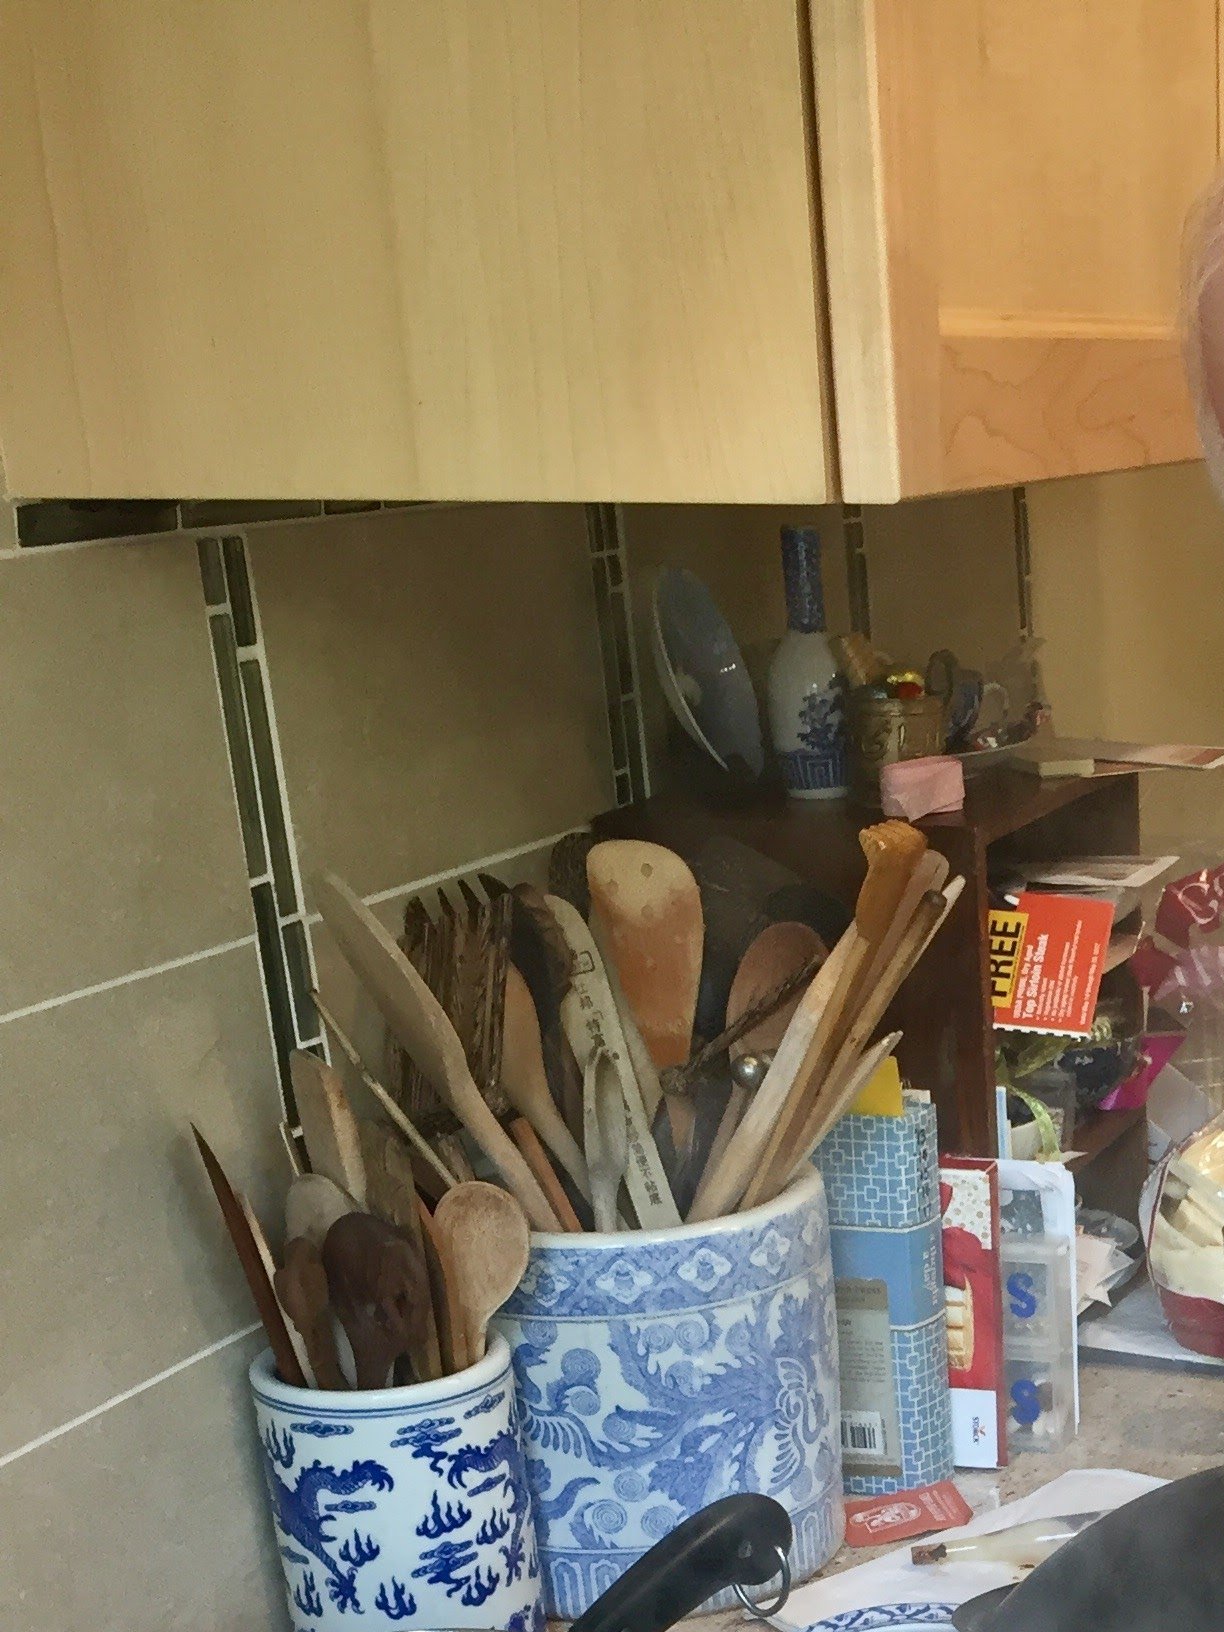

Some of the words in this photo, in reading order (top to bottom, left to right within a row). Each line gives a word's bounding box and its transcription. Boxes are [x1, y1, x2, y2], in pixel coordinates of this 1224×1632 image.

[990, 920, 1021, 998] FREE
[1033, 933, 1049, 962] Steak
[1026, 964, 1042, 998] Sirloin
[1022, 999, 1037, 1019] Top
[1006, 1272, 1037, 1318] S
[1010, 1379, 1041, 1426] S
